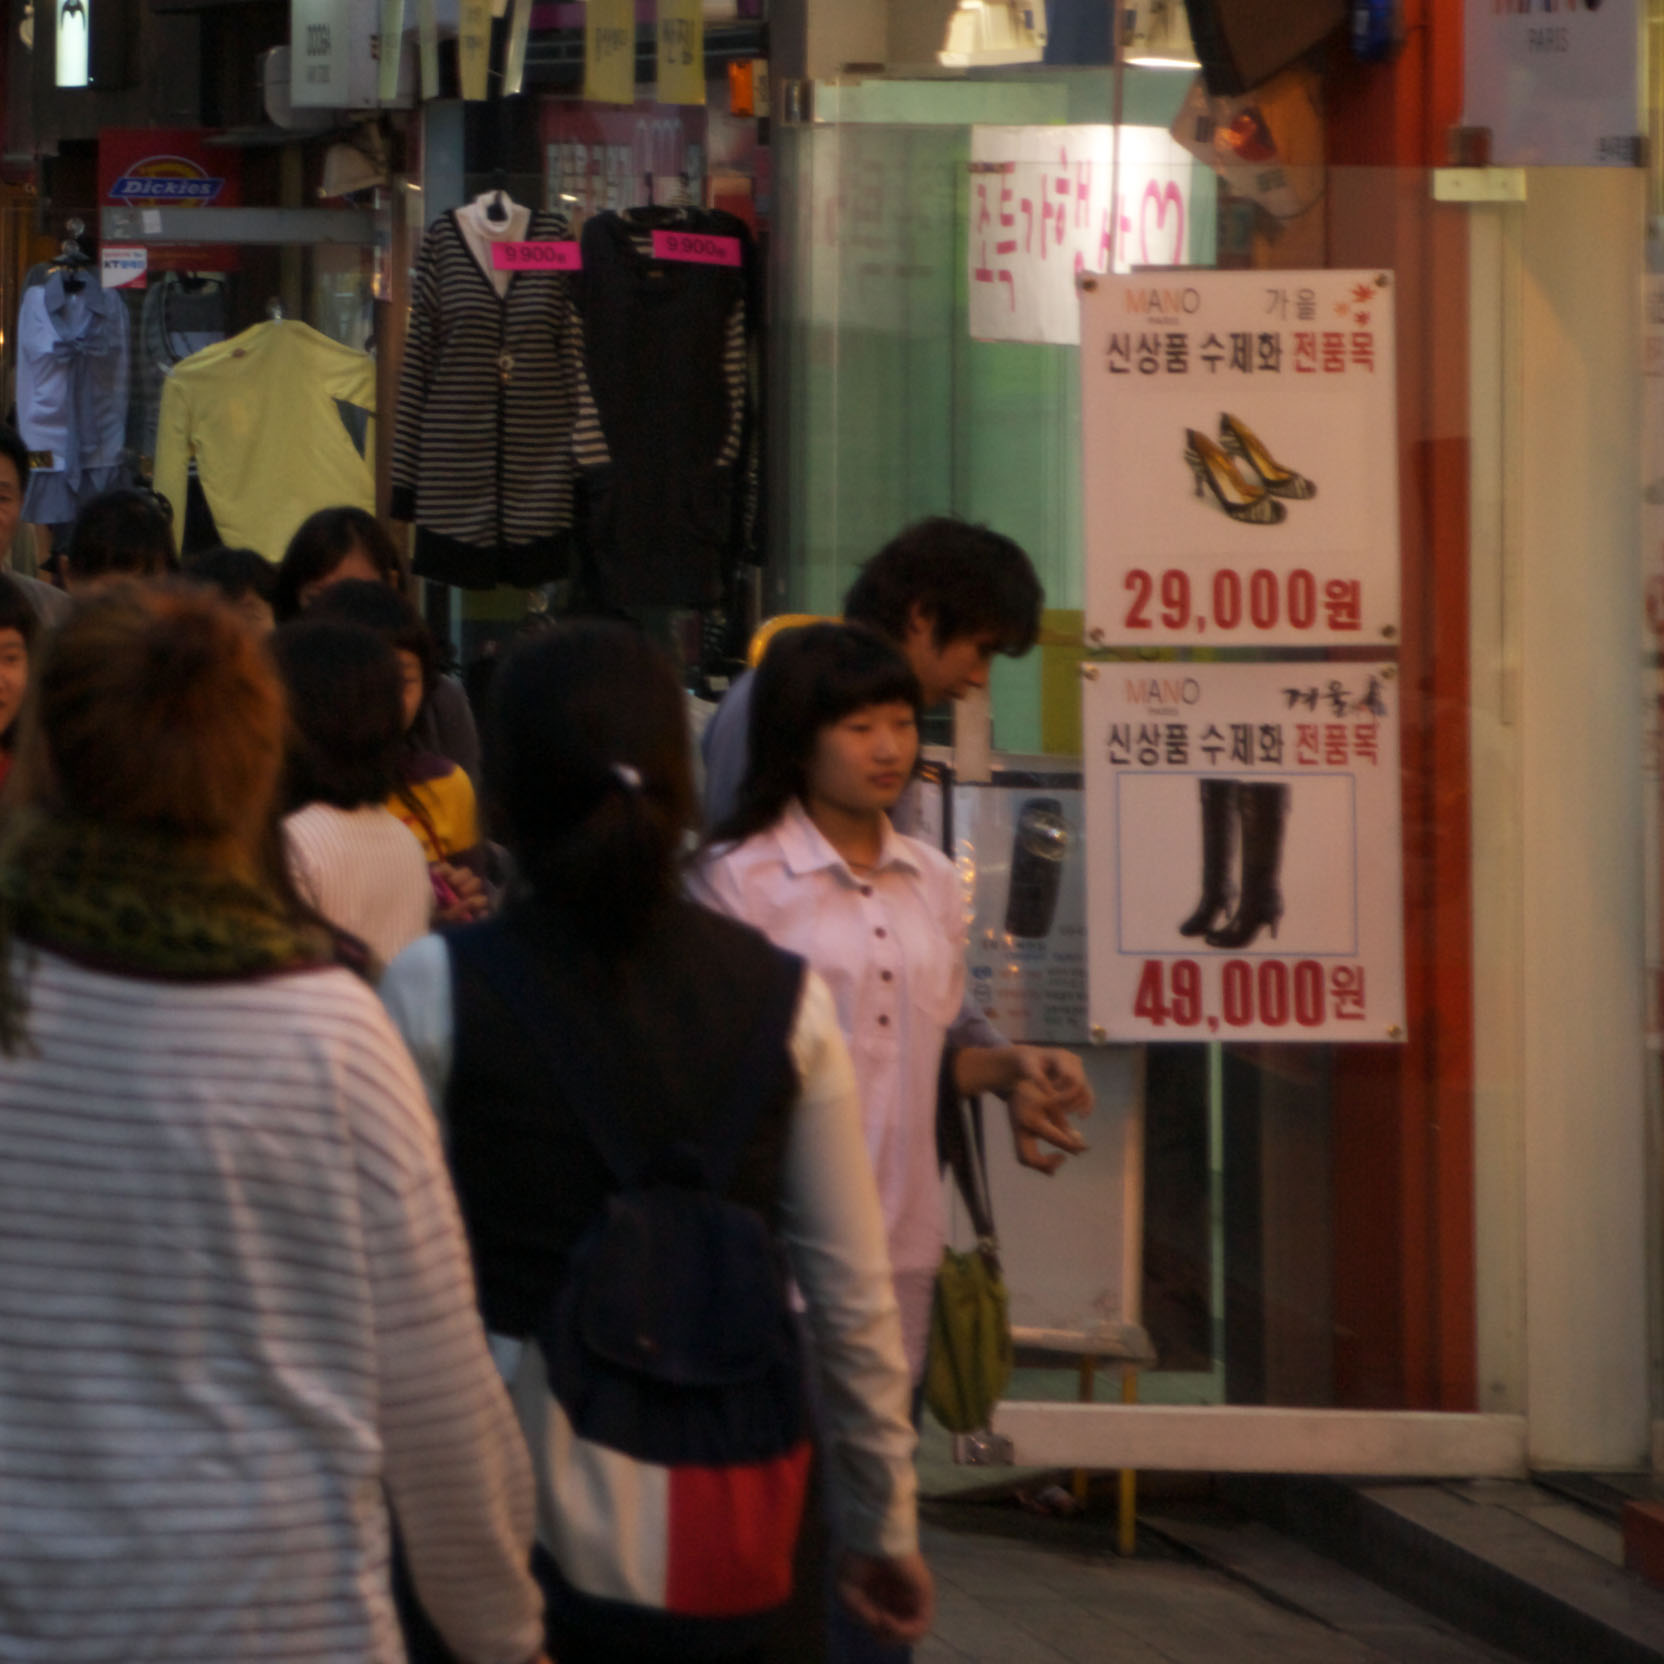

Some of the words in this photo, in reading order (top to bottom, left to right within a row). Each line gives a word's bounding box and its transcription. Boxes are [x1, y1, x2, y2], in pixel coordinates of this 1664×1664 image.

[122, 176, 214, 199] Dickies
[1124, 287, 1201, 314] MANO
[1264, 287, 1318, 321] 가을
[1106, 331, 1190, 375] 신상품
[1200, 330, 1284, 375] 수제화
[1293, 330, 1376, 375] 전품목
[1123, 568, 1363, 633] 29,000원
[1124, 677, 1201, 706] MANO
[1107, 722, 1190, 767] 신상품
[1200, 722, 1285, 767] 수제화
[1295, 721, 1381, 767] 전품목
[1133, 958, 1367, 1029] 49,000원
